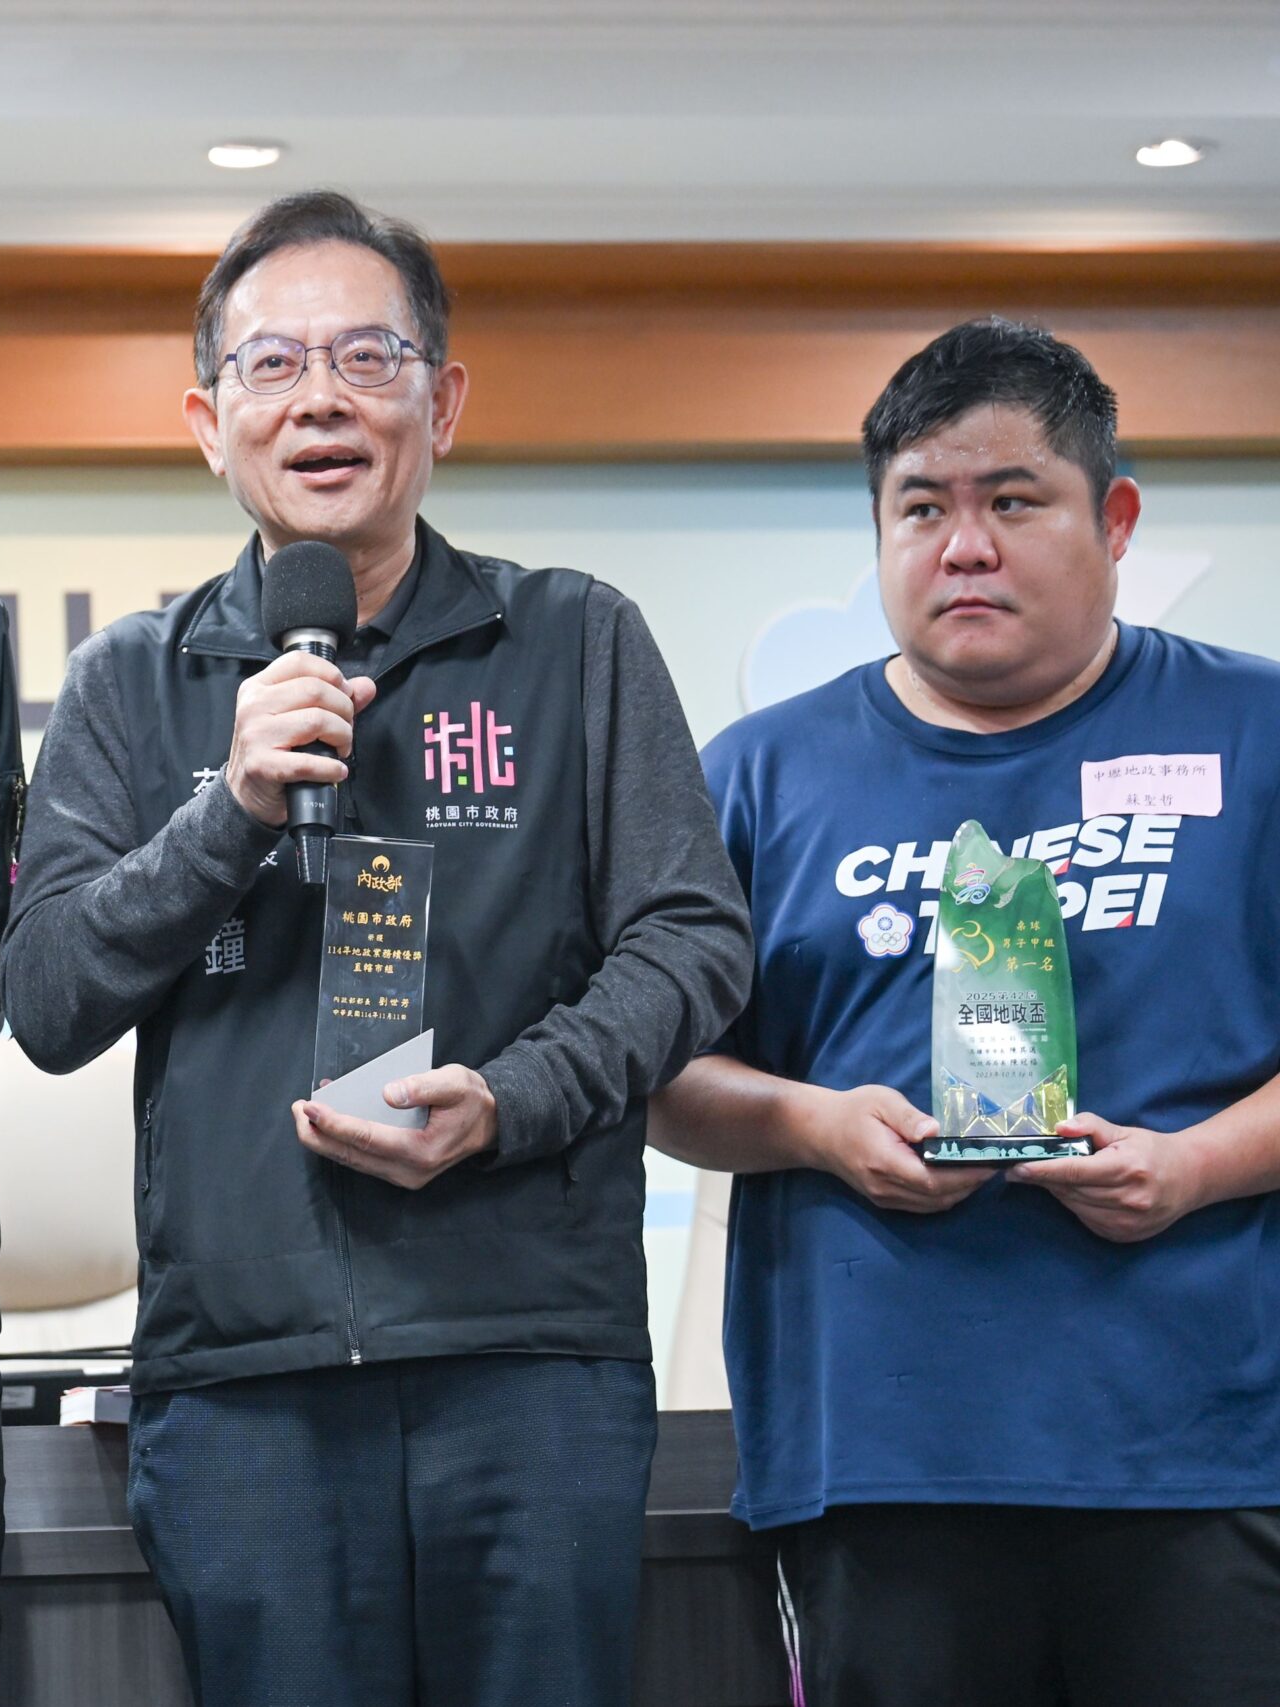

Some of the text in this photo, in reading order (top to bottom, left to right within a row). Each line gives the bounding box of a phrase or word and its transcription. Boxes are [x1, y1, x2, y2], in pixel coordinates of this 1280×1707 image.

[425, 804, 519, 823] 桃園市政府
[475, 822, 519, 830] GOVERNMENT
[342, 910, 413, 928] 桃園市政府
[353, 962, 395, 975] 直轄市組
[1006, 956, 1054, 974] 第一名
[958, 1002, 1047, 1026] 全國地政盃
